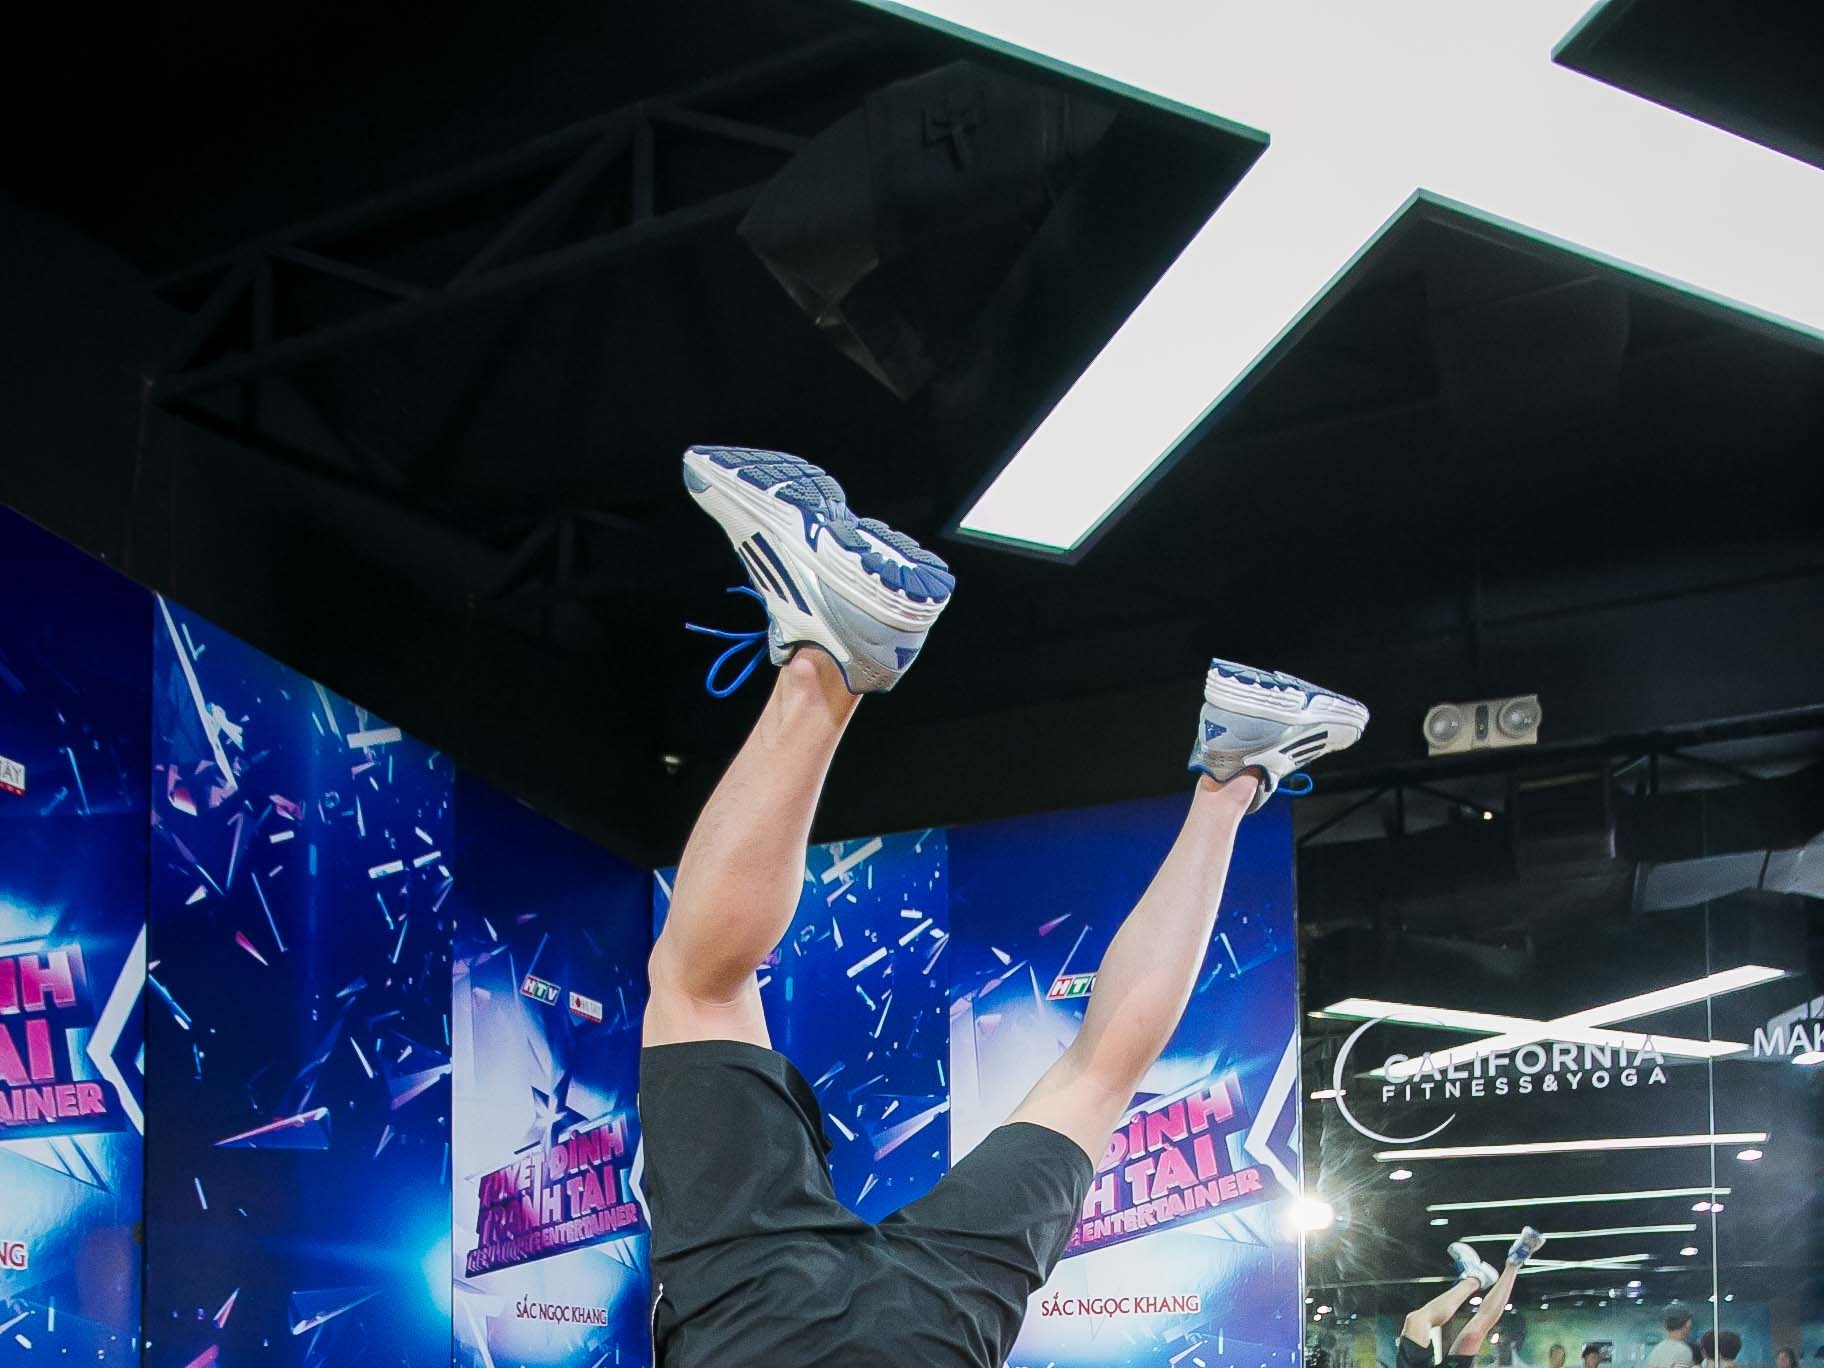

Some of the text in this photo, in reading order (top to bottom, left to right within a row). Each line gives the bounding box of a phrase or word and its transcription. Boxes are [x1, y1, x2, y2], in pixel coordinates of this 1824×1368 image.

[522, 977, 558, 1002] HTV
[1384, 1034, 1665, 1084] CALIFORNIA
[567, 1165, 617, 1218] TÀI
[1125, 1134, 1218, 1205] TÀI
[543, 1203, 638, 1247] ENTERTAINER
[1083, 1168, 1263, 1242] ENTERTAINER
[539, 1303, 570, 1325] NGỌC
[571, 1306, 607, 1325] KHANG
[1078, 1298, 1130, 1318] NGỌC
[1134, 1295, 1199, 1313] KHANG
